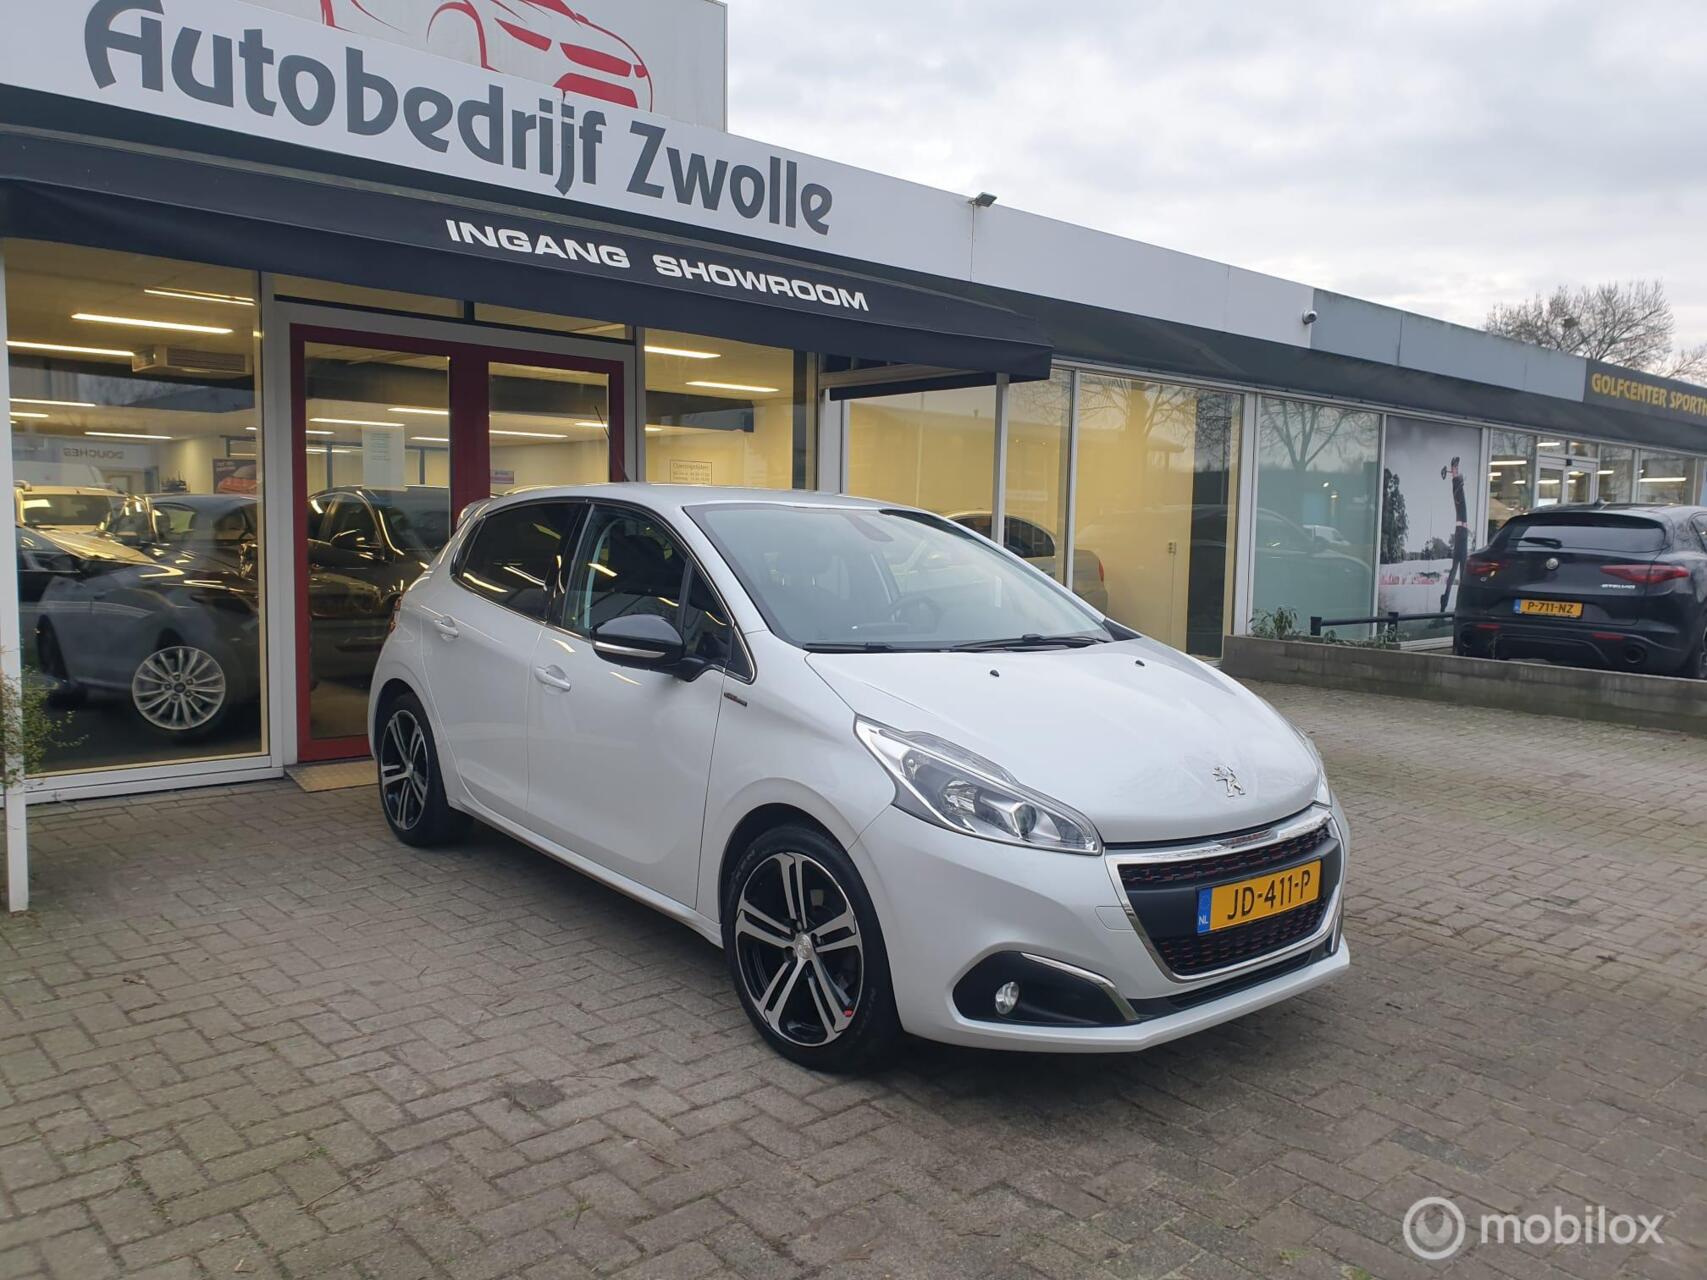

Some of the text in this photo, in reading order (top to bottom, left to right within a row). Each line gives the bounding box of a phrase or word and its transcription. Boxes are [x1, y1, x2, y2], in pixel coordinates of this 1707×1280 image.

[84, 0, 833, 235] Autobedrijf Zwolle
[446, 219, 869, 311] INGANG SHOWROOM
[1591, 373, 1667, 408] GOLFCENTER
[1527, 601, 1574, 614] P-711-NZ
[1227, 869, 1311, 920] JD-411-P
[1199, 915, 1208, 925] NL
